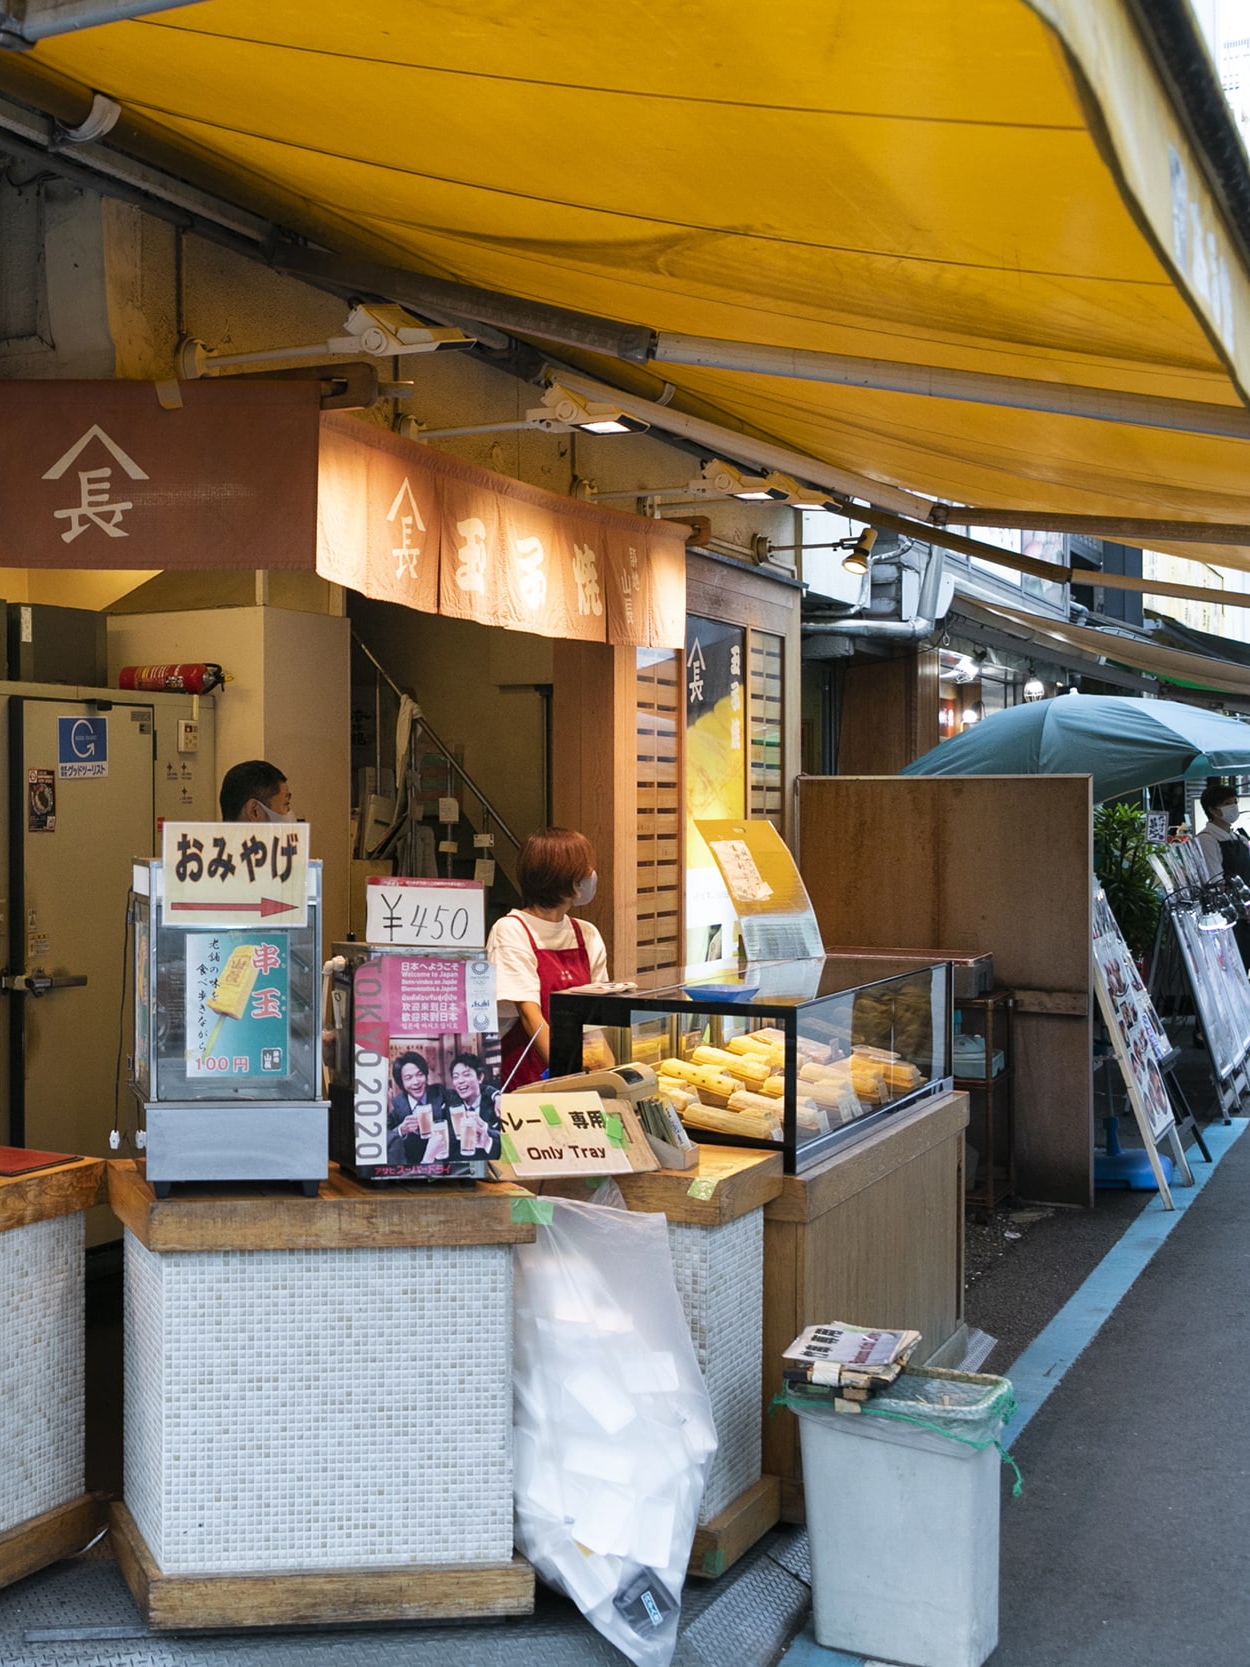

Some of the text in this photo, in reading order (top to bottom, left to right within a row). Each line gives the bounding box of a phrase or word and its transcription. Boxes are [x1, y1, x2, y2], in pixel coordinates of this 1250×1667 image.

[175, 832, 298, 883] おみやげ
[380, 893, 469, 942] ¥450
[252, 942, 281, 1019] 串玉
[401, 962, 459, 971] 日本へようこそ
[354, 1078, 383, 1160] 2020
[568, 1110, 608, 1131] 専用
[527, 1145, 606, 1161] Only Tray
